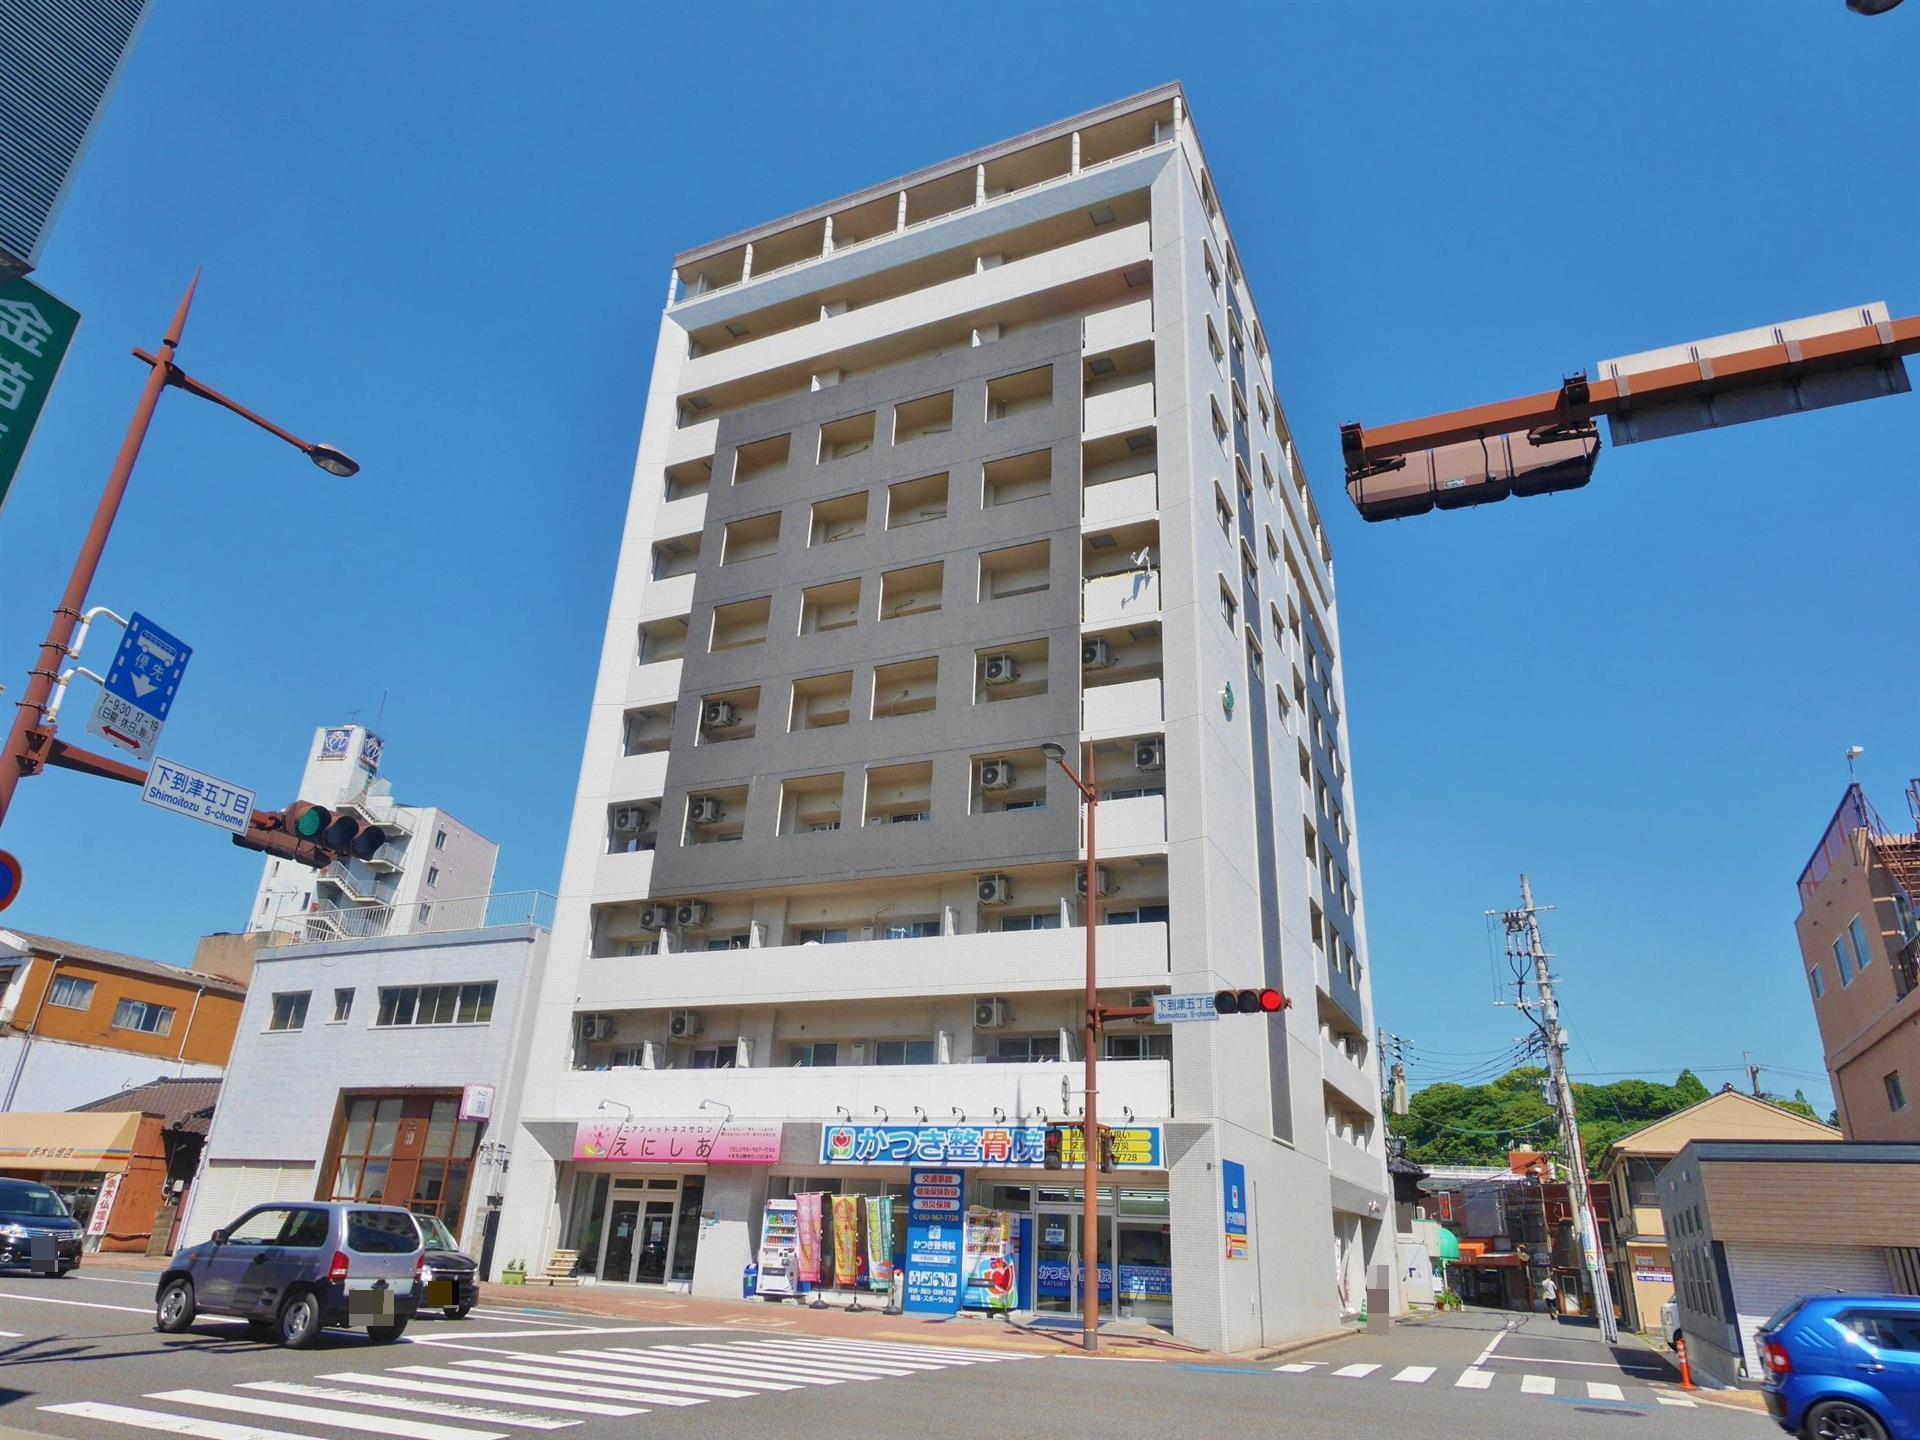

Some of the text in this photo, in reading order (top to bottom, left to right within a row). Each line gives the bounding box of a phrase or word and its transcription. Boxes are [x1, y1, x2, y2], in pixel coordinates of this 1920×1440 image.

[134, 653, 164, 682] 優先
[158, 764, 250, 814] 下到津五丁目
[148, 786, 244, 828] Shimoitozu 5-chome
[1157, 996, 1215, 1011] 下到津五丁目
[613, 1137, 712, 1158] えにしあ
[855, 1128, 1045, 1163] かつき整骨院
